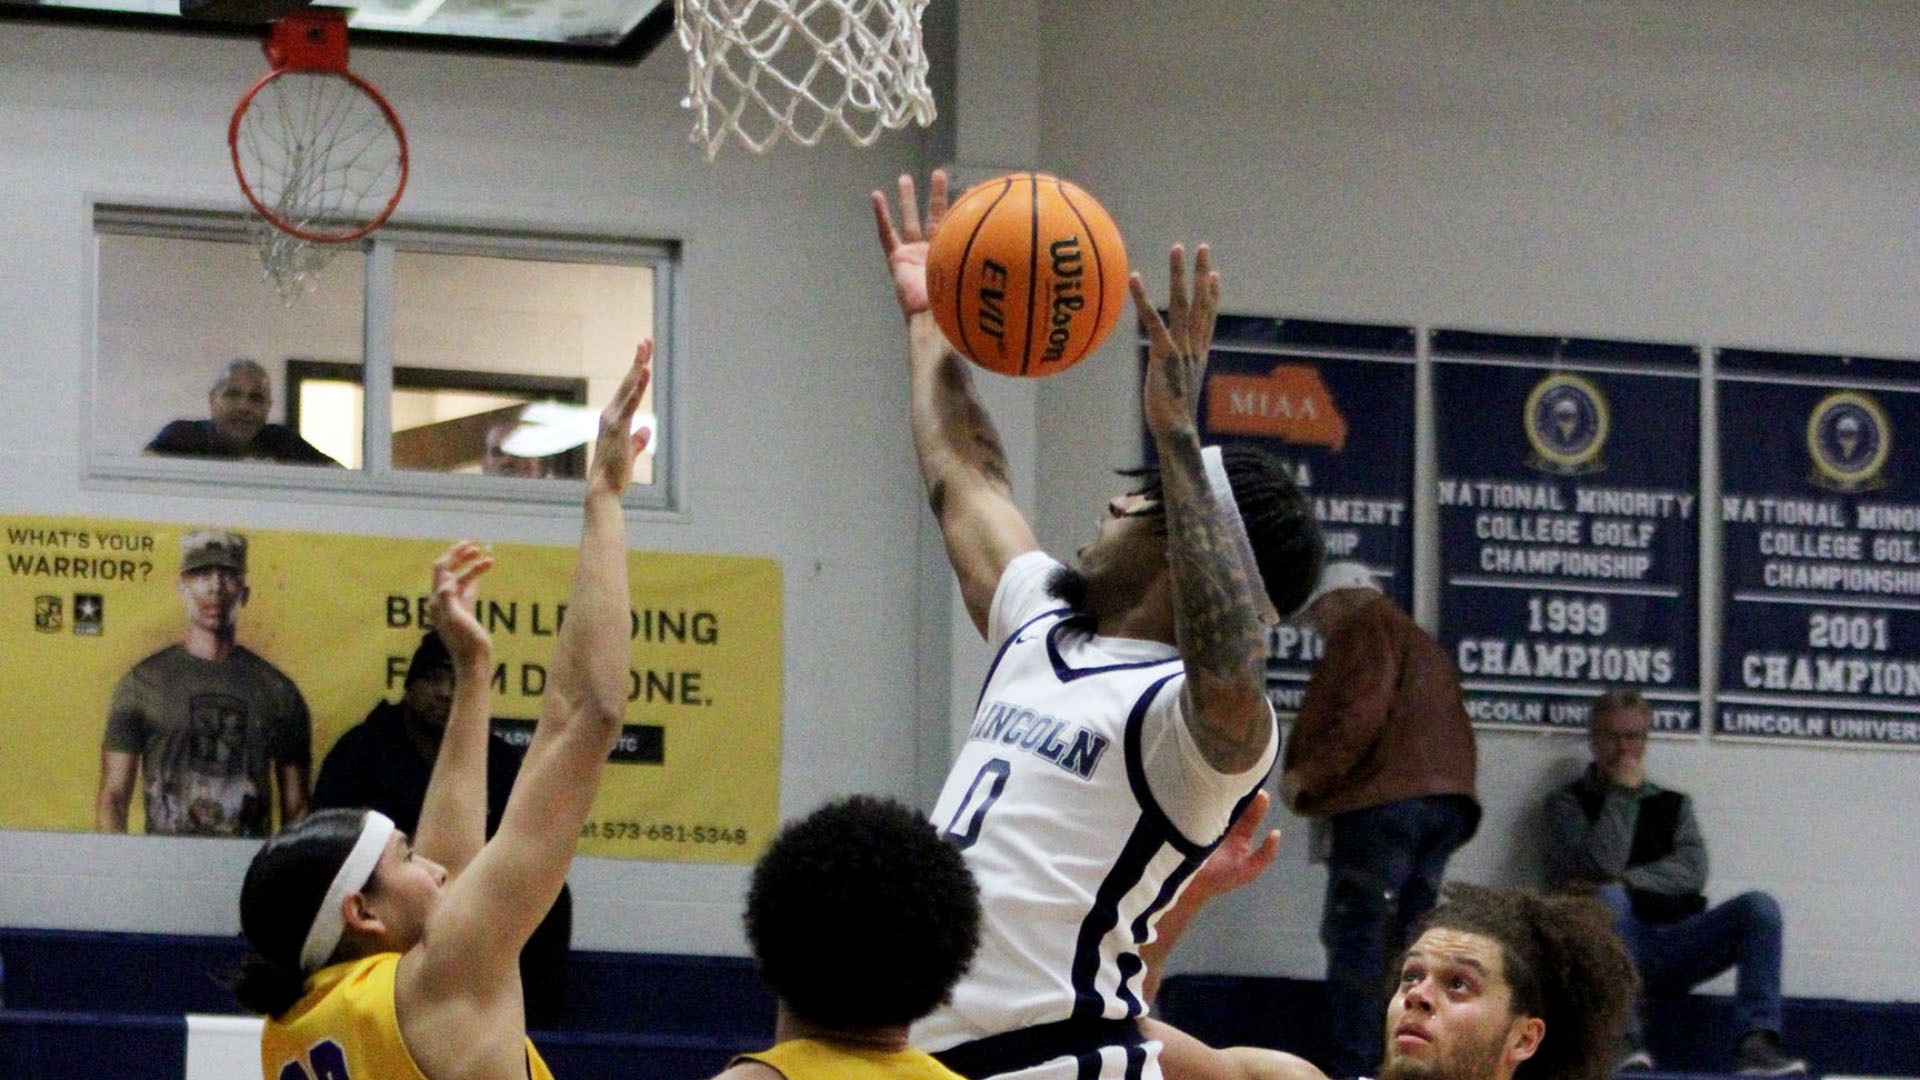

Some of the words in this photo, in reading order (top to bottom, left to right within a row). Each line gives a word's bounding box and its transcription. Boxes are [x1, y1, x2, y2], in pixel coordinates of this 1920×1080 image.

[1040, 236, 1084, 363] Wilson
[1230, 389, 1318, 419] MIAA
[1438, 480, 1564, 511] NATIONAL
[1576, 488, 1694, 519] MINORITY
[1722, 497, 1845, 528] NATIONAL
[1857, 505, 1920, 533] MINO
[7, 528, 90, 549] WHAT'S
[97, 533, 155, 553] YOUR
[1476, 515, 1581, 545] COLLEGE
[1591, 521, 1655, 549] GOLF
[1760, 531, 1863, 560] COLLEGE
[1873, 537, 1920, 564] GOL
[7, 553, 154, 583] WARRIOR?
[1480, 547, 1651, 580] CHAMPIONSHIP
[1764, 563, 1920, 597] CHAMPIONSHI
[386, 595, 517, 634] BEIN
[1528, 599, 1608, 637] 1999
[1809, 614, 1887, 651] 2001
[1457, 640, 1674, 684] CHAMPIONS
[1463, 701, 1543, 721] NCOLN
[1722, 711, 1825, 737] LINCOLN
[1830, 718, 1920, 743] UNIVER
[949, 757, 1011, 850] 0
[602, 822, 747, 845] 573-681-5348
